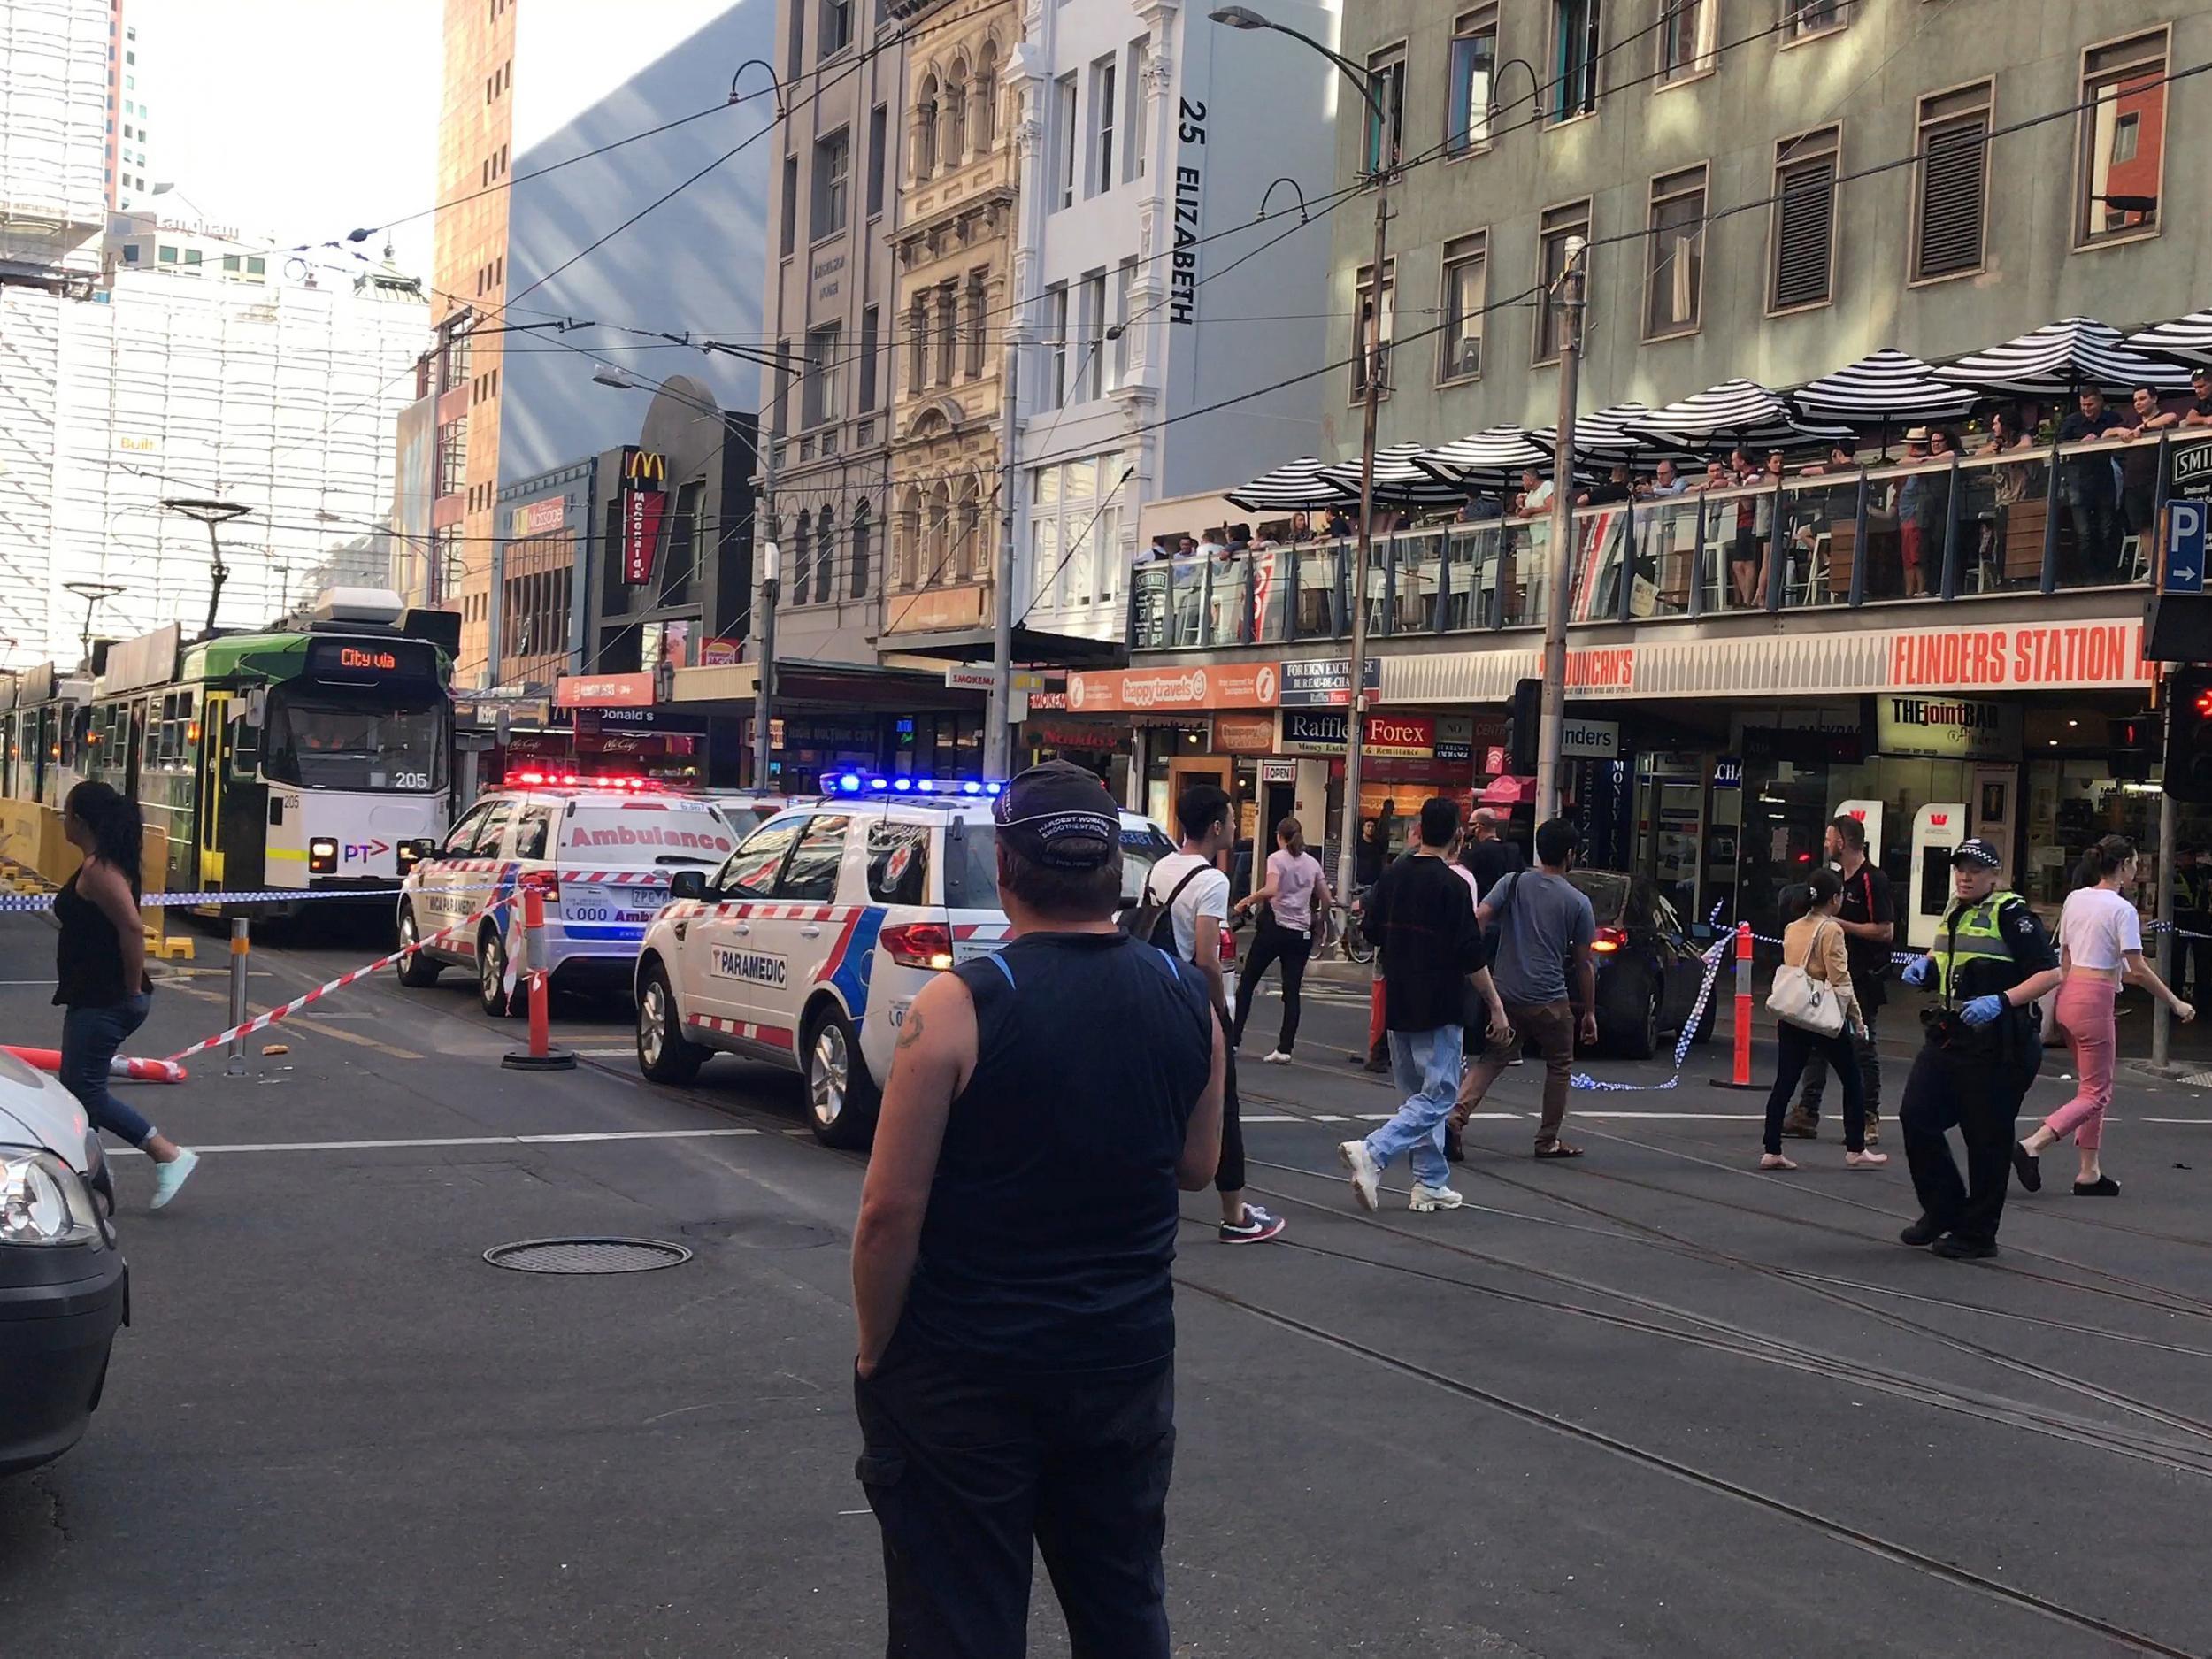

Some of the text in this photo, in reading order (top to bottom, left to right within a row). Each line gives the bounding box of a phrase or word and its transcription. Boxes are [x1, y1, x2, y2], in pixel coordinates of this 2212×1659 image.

[1170, 96, 1207, 326] 25 ELIZABETH
[2171, 505, 2200, 552] P
[342, 648, 395, 669] City via
[1893, 631, 2007, 685] FLINDERS
[2014, 626, 2125, 683] STATION
[1287, 663, 1325, 677] FOREIGN
[1370, 719, 1425, 743] Forex
[396, 772, 428, 787] 205
[1269, 766, 1290, 779] OPEN
[284, 795, 300, 809] 205
[571, 826, 732, 853] Ambulance
[577, 908, 608, 921] 000
[721, 951, 787, 984] PARAMEDIC
